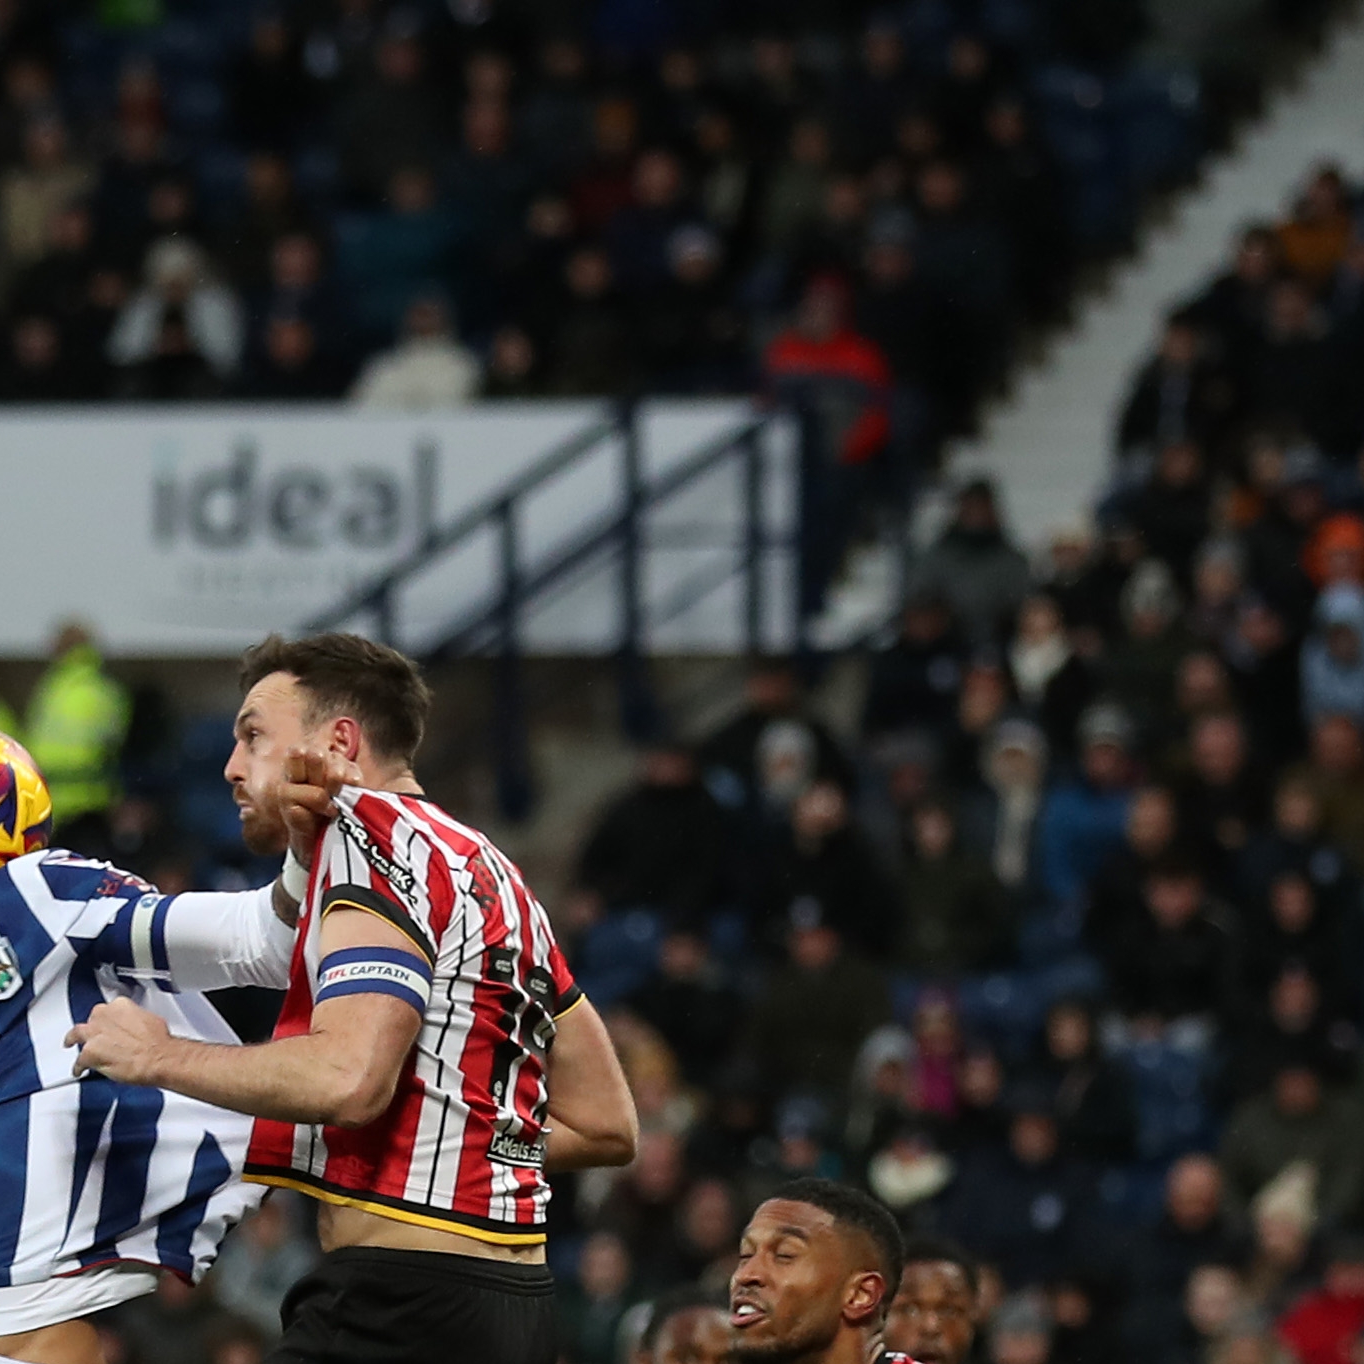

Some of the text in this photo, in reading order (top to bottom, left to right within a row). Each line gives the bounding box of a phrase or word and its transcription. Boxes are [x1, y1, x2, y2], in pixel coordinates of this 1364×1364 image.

[148, 434, 439, 551] ideal
[327, 965, 411, 982] EFL CAPTAIN
